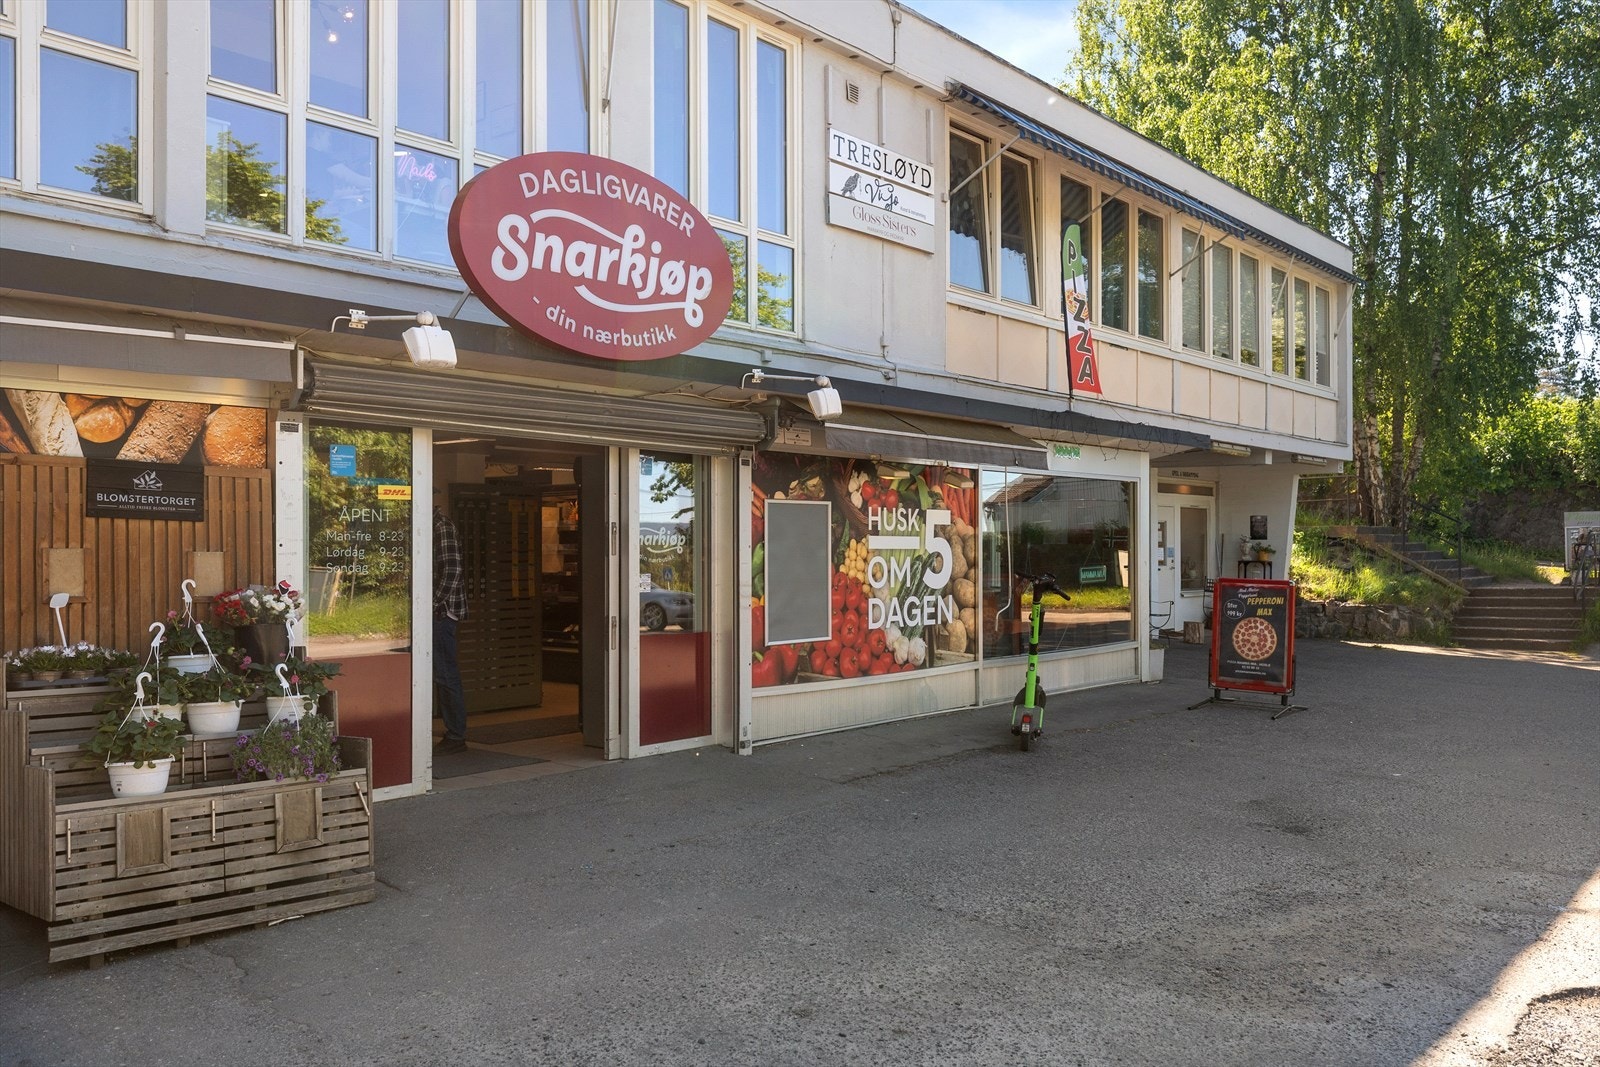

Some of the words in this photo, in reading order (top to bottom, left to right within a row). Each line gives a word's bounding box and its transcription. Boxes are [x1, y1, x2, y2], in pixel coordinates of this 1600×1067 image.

[833, 134, 932, 189] TRESLØYD
[518, 168, 696, 238] DAGLIGVARER
[852, 205, 881, 226] Gloss
[882, 214, 917, 237] Sisters
[491, 213, 713, 328] Snarkjøp
[545, 304, 577, 333] din
[582, 323, 678, 348] nærbutikk
[1067, 238, 1095, 386] PIZZA
[96, 492, 196, 506] BLOMSTERTORGET
[338, 505, 393, 522] ÅPENT
[326, 531, 372, 541] Man-fre
[378, 531, 404, 542] 8-23
[640, 527, 686, 554] narkjøp
[868, 506, 920, 532] HUSK
[922, 509, 953, 590] 5
[326, 547, 365, 559] Lørdag
[379, 547, 404, 557] 9-23
[326, 563, 369, 575] Søndag
[379, 562, 404, 573] 9-23
[868, 556, 911, 589] OM
[868, 594, 953, 630] DAGEN
[1247, 597, 1284, 605] PEPPERONI
[1256, 608, 1273, 616] MAX
